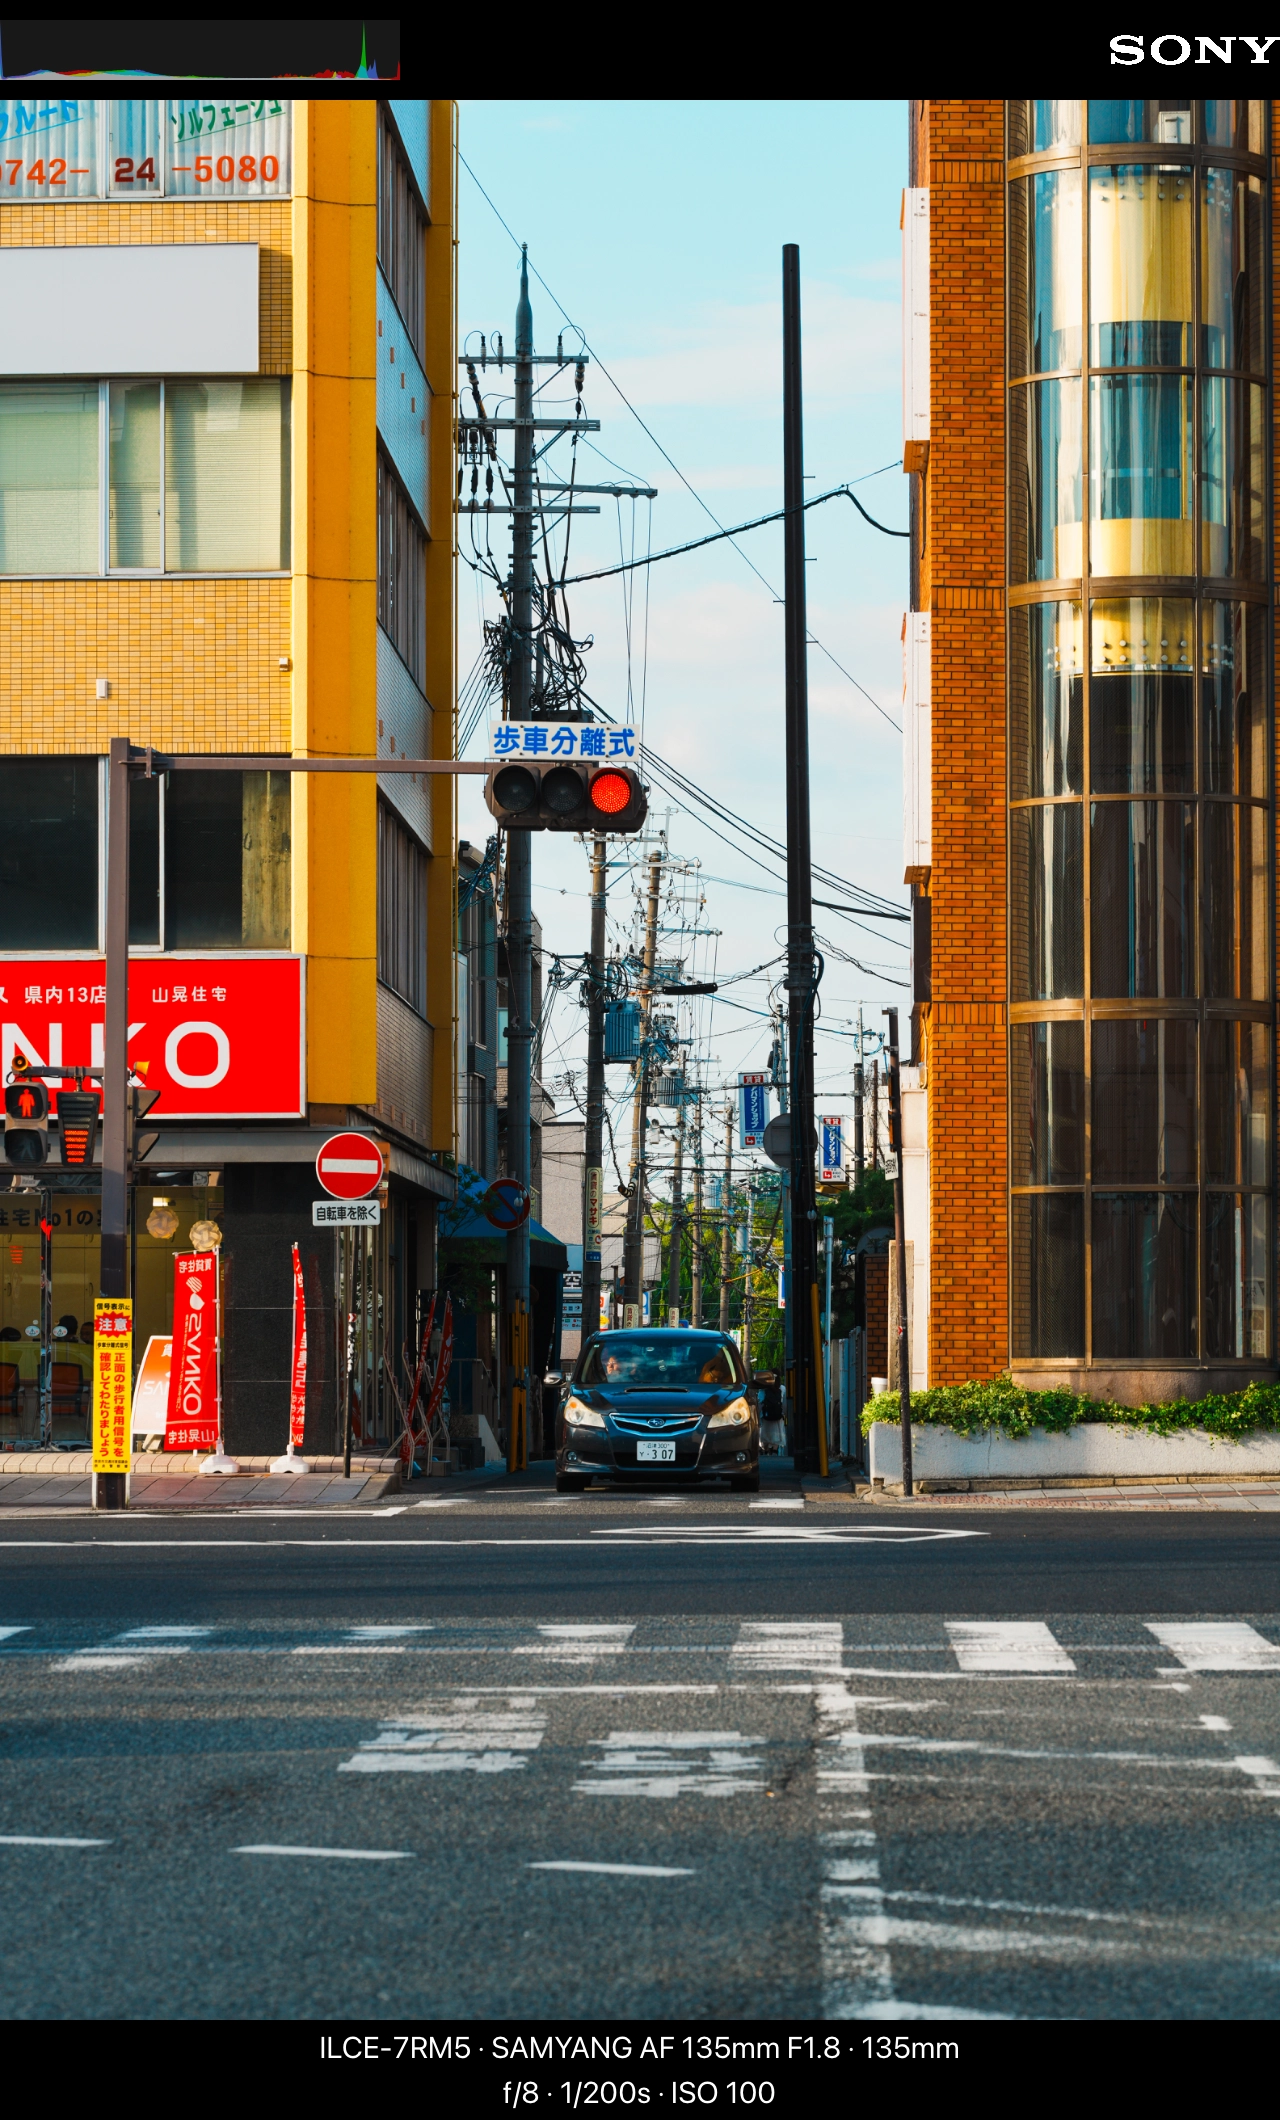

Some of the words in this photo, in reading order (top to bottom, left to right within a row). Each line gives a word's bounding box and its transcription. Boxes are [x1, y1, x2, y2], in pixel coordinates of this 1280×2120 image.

[0, 158, 89, 185] 742-
[115, 157, 156, 183] 24
[493, 725, 635, 757] 歩車分離式
[152, 986, 227, 1003] 山晃住宅
[317, 1205, 377, 1221] 自転車を除く
[99, 1318, 128, 1332] 注意
[99, 1351, 111, 1457] 確認してわたりましょう
[113, 1352, 126, 1457] 正面の歩行者用信号を
